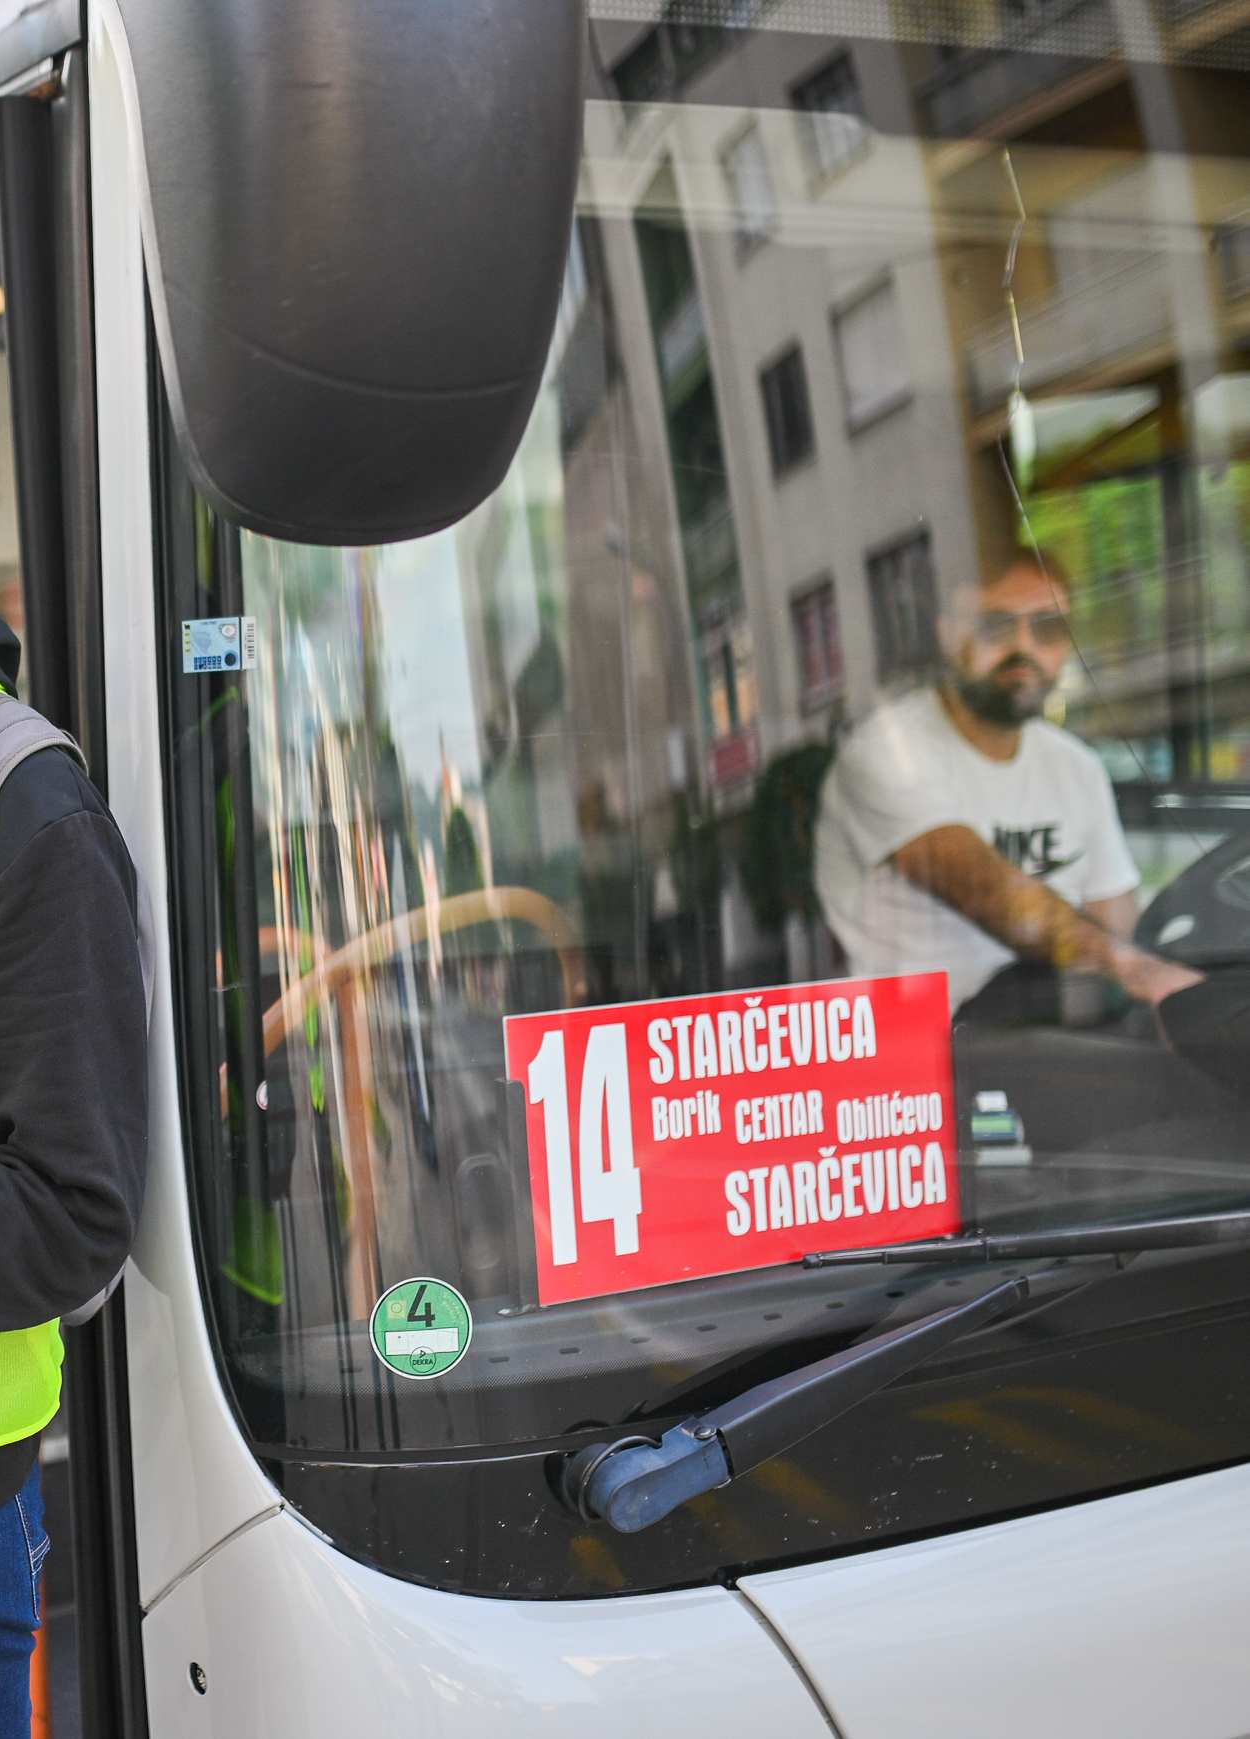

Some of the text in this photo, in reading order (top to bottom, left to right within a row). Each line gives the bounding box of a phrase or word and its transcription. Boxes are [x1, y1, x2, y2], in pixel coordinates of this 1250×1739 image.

[994, 823, 1060, 868] NIKE
[648, 996, 877, 1085] STARČEVICA
[528, 1023, 642, 1266] 14
[652, 1090, 943, 1144] Borik CENTAR Obilićevo
[725, 1142, 947, 1237] STARČEVICA
[408, 1285, 435, 1327] 4
